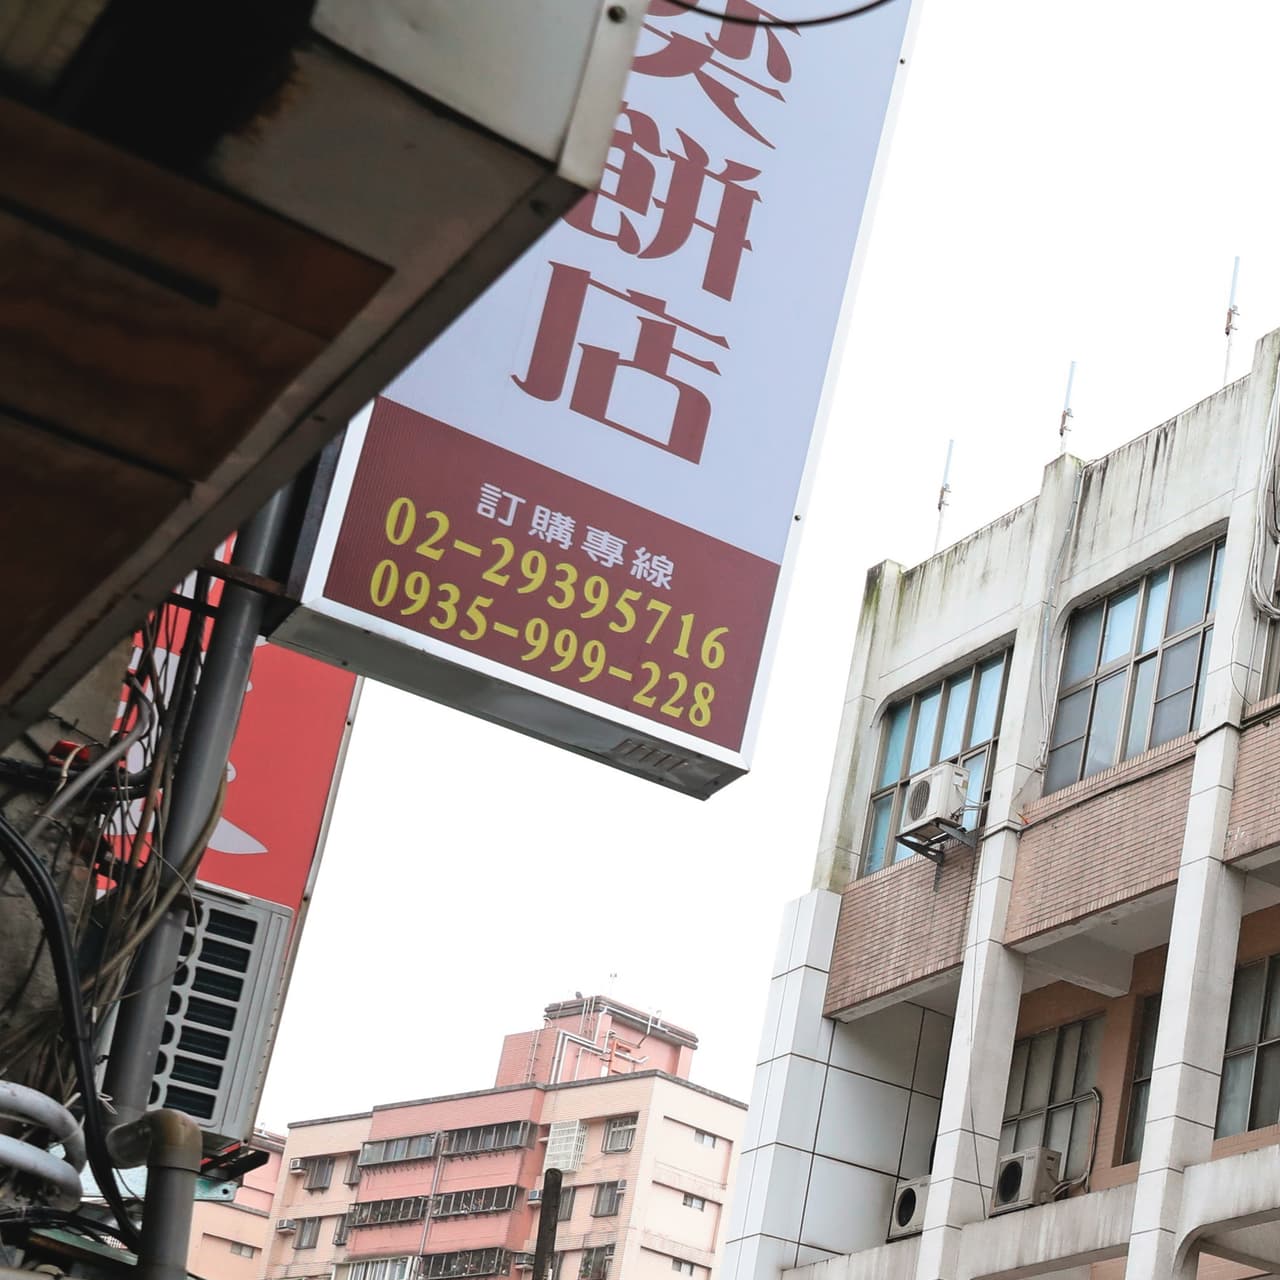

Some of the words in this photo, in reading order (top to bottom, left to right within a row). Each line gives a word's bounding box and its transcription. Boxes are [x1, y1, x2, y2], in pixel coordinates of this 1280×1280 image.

[385, 496, 729, 670] 02-29395716
[477, 484, 675, 589] 訂購專線
[369, 559, 714, 728] 0935-999-228
